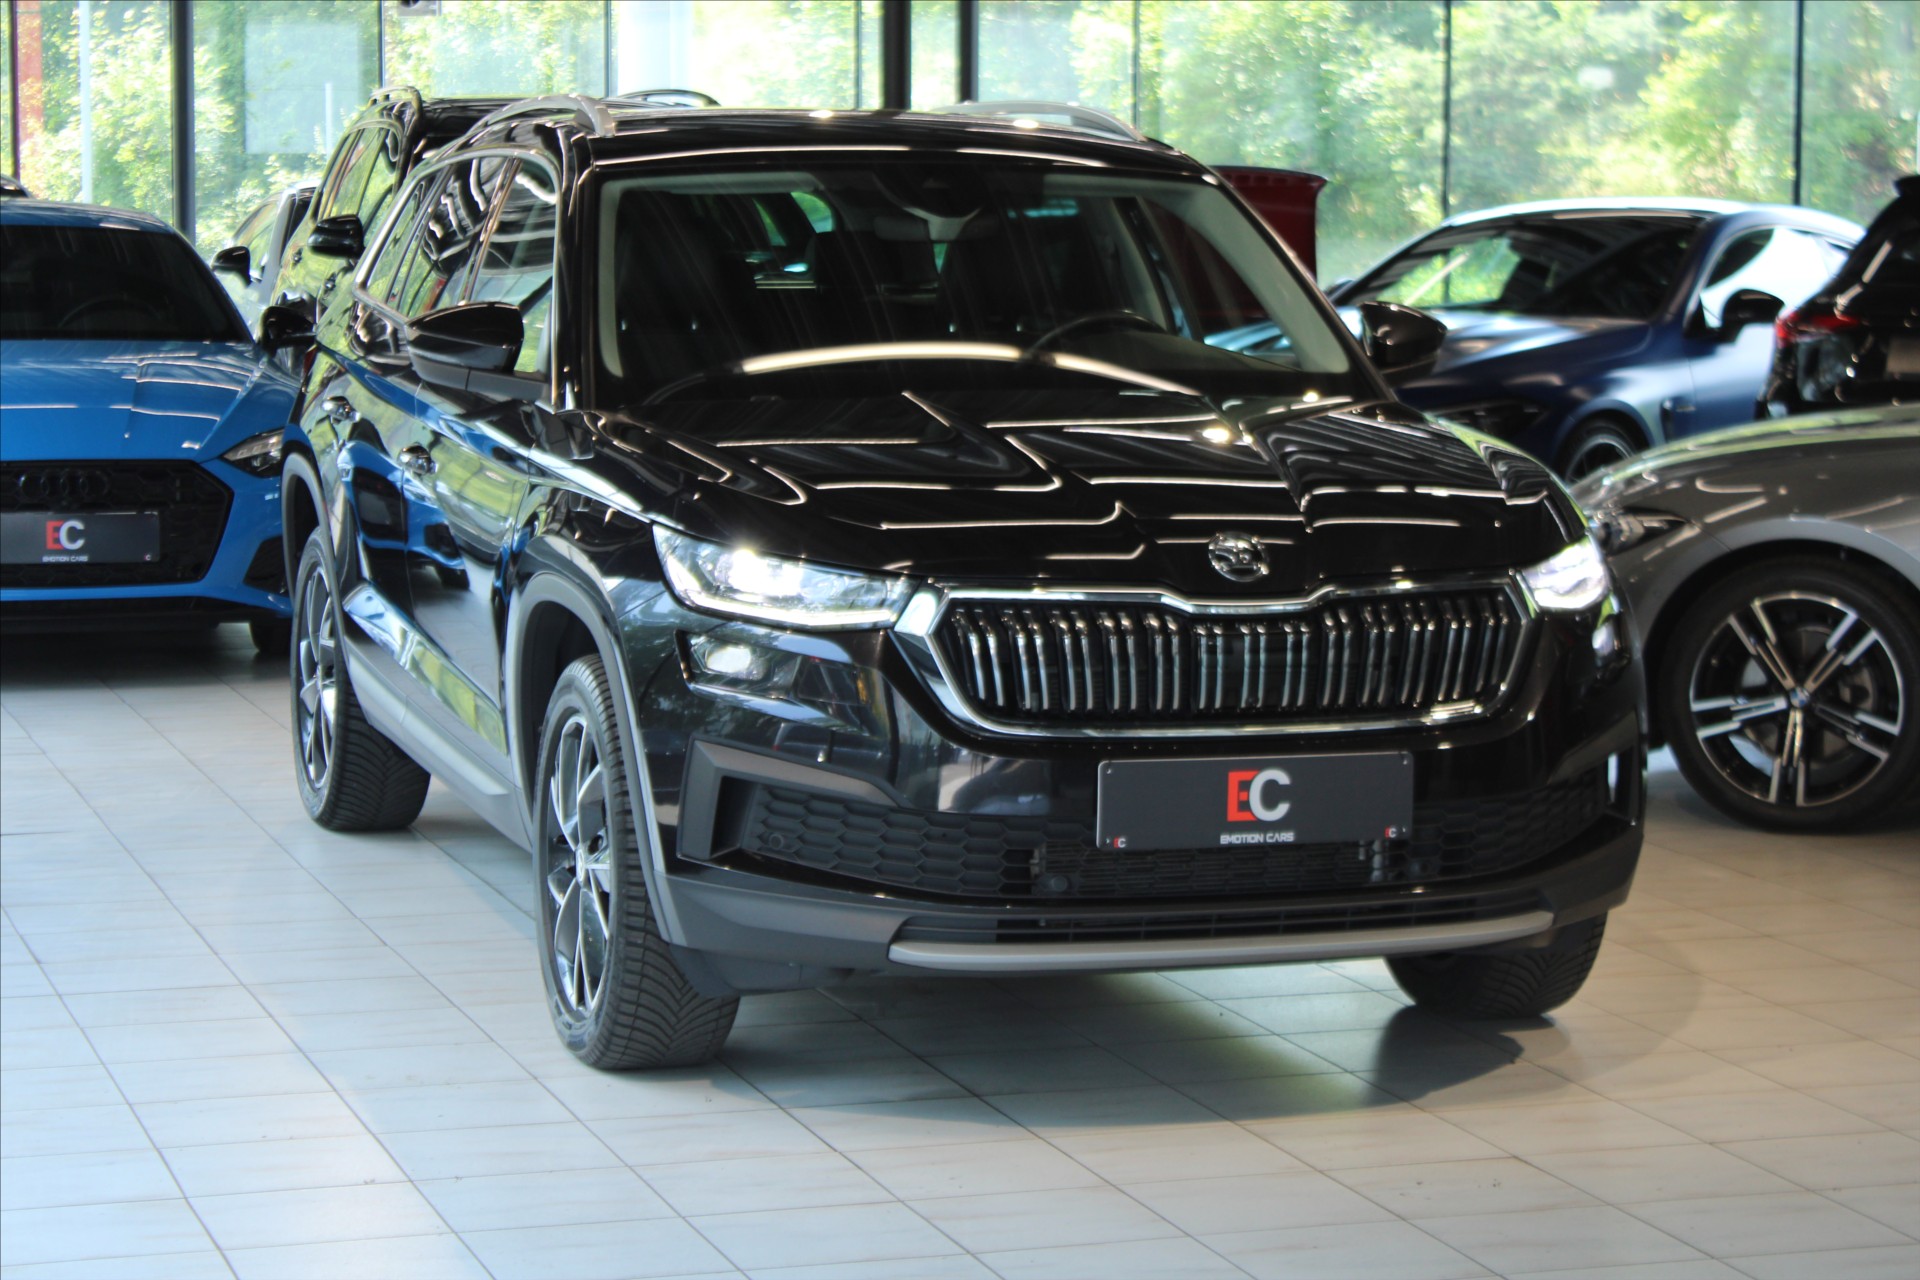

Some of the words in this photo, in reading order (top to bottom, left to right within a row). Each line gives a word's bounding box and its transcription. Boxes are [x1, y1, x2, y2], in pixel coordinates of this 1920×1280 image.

[46, 519, 85, 550] EC
[1227, 768, 1291, 822] EC
[1220, 833, 1264, 844] EMOTION
[1265, 832, 1294, 843] CARS
